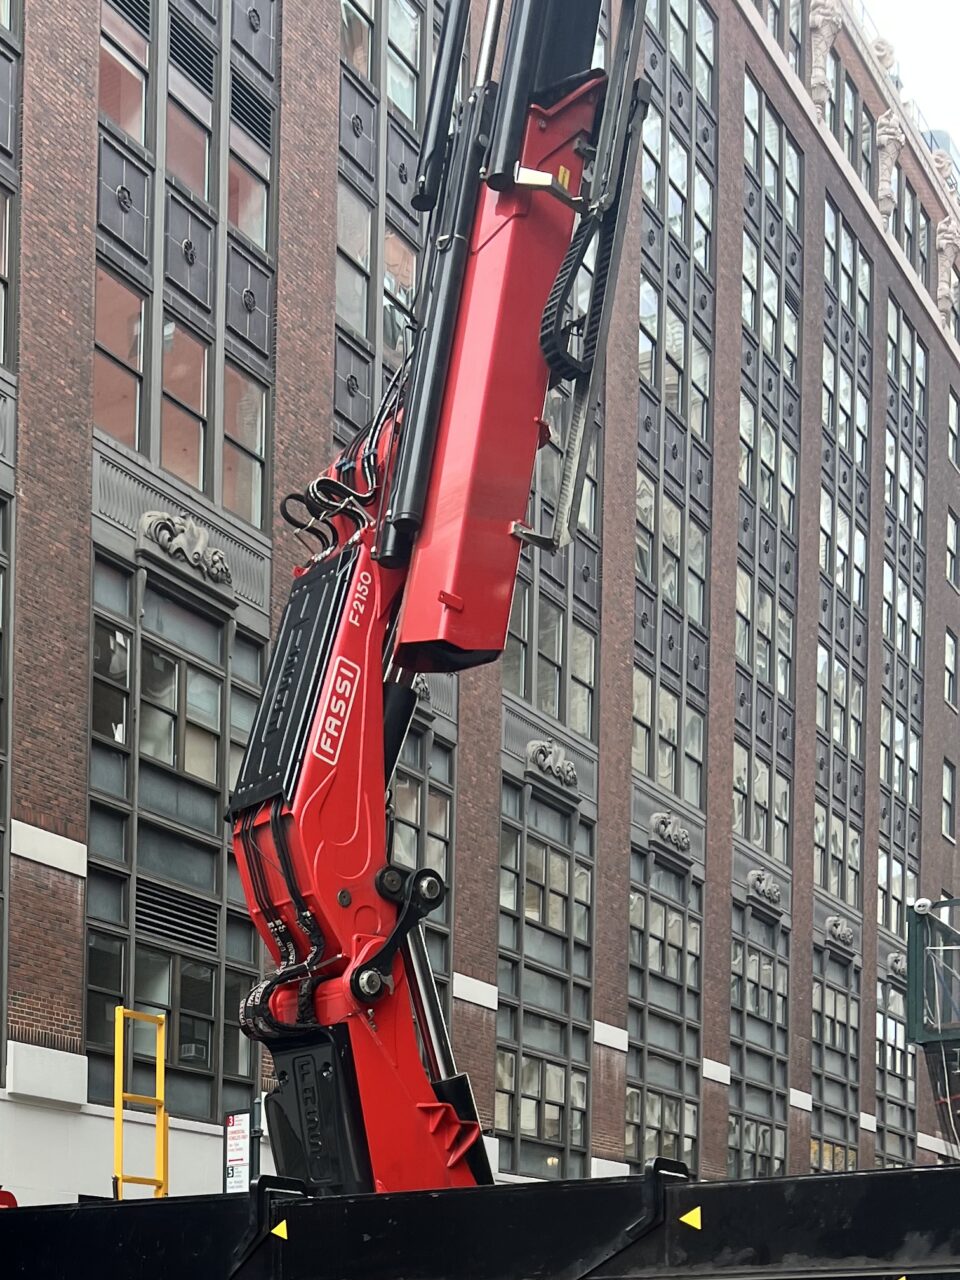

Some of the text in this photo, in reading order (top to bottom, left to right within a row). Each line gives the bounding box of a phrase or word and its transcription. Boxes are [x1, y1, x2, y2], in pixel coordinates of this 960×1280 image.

[348, 570, 372, 628] F2150
[320, 662, 355, 756] FASSI
[227, 1115, 234, 1126] 3
